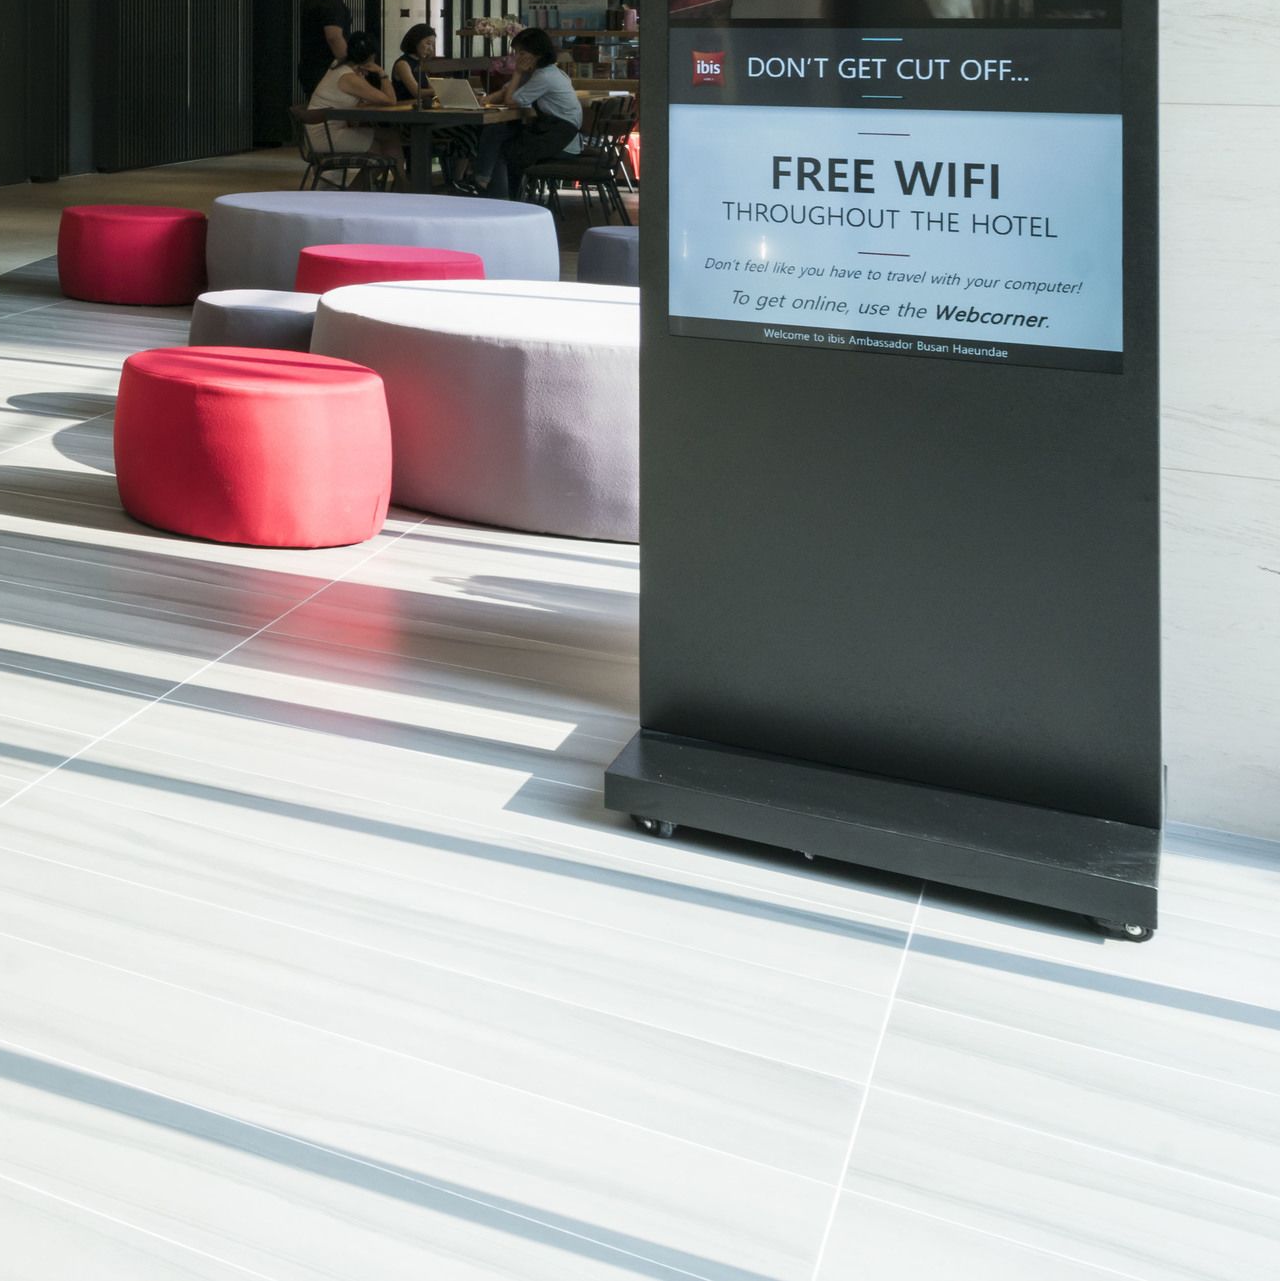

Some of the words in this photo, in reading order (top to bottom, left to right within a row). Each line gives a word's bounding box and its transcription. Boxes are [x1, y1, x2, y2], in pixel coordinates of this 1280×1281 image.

[696, 59, 721, 74] ibis
[748, 56, 829, 78] DON'T
[839, 58, 887, 79] GET
[897, 59, 950, 80] CUT
[960, 59, 1030, 82] OFF...
[772, 155, 876, 194] FREE
[894, 160, 1000, 200] WIFI
[722, 201, 900, 229] THROUGHOUT
[910, 210, 960, 233] THE
[972, 214, 1058, 238] HOTEL
[705, 257, 740, 271] Don't
[744, 260, 769, 273] feel
[773, 262, 795, 275] like
[798, 267, 824, 278] you
[829, 265, 862, 280] have
[867, 269, 881, 281] to
[887, 270, 927, 283] travel
[931, 272, 960, 286] with
[964, 278, 1000, 290] your
[1004, 279, 1083, 295] computer!
[731, 290, 750, 305] To
[755, 295, 786, 311] get
[792, 296, 850, 315] online,
[858, 303, 890, 316] use
[897, 302, 927, 319] the
[936, 304, 1050, 329] Webcorner.
[763, 328, 810, 341] Welcome
[813, 333, 824, 342] to
[828, 333, 845, 344] ibis
[848, 336, 913, 350] Ambassador
[917, 340, 949, 353] Busan
[953, 344, 1008, 358] Haeundae
